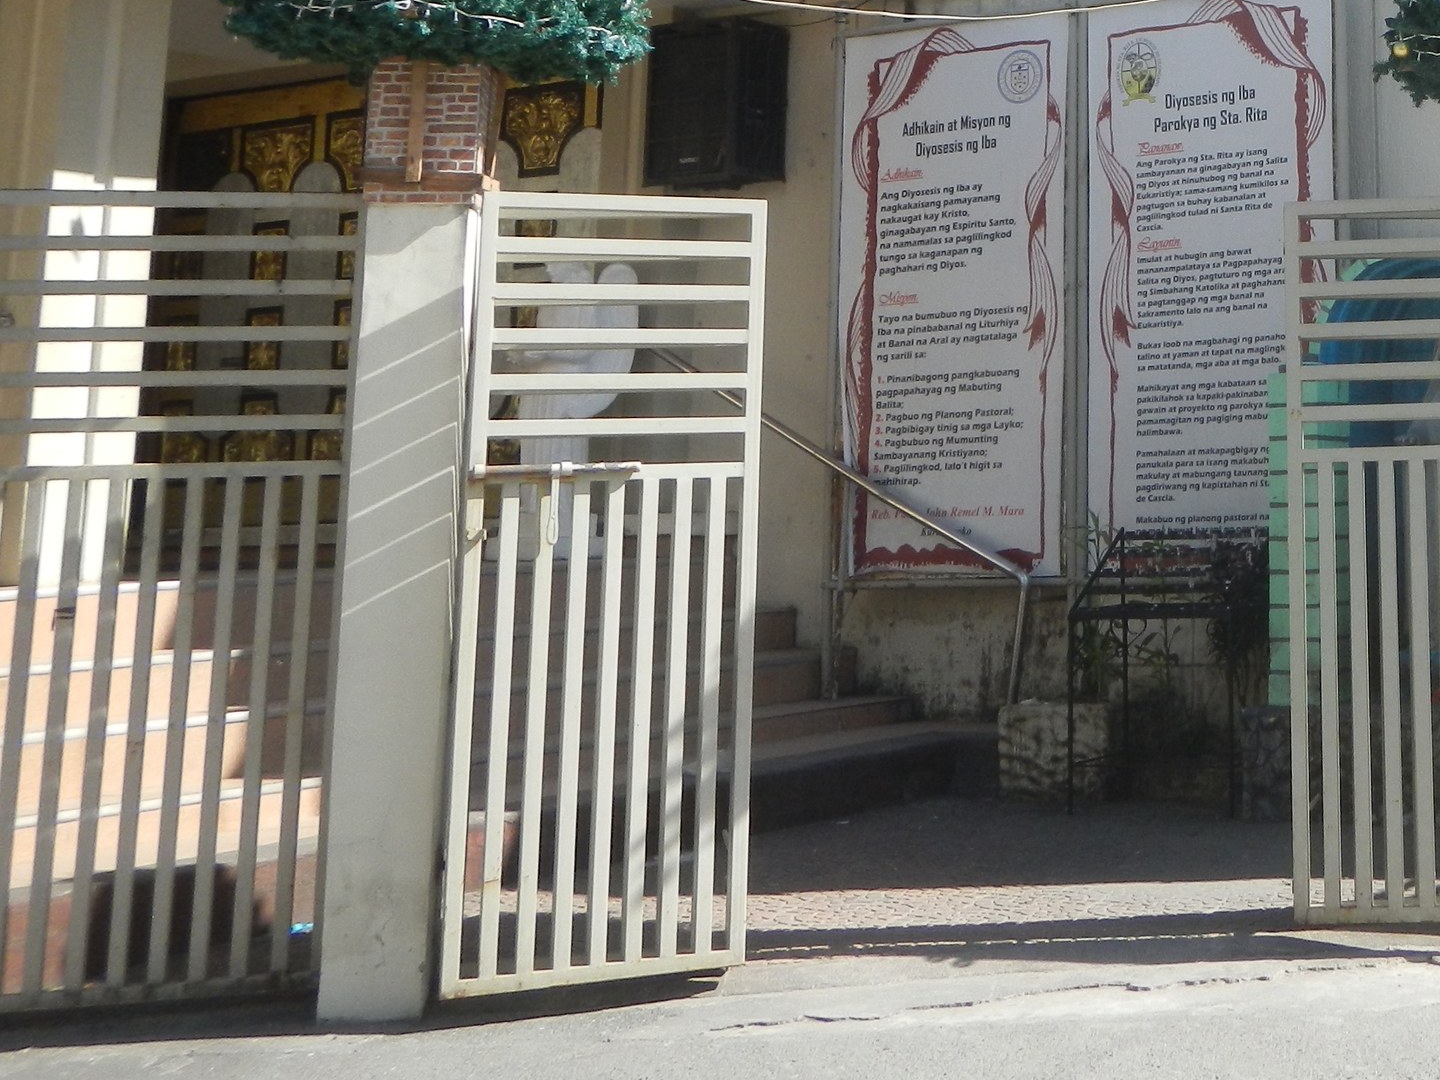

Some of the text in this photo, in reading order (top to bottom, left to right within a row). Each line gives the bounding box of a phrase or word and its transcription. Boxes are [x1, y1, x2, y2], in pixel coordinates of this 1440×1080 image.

[1165, 85, 1255, 111] Diyosesis ng Iba
[902, 115, 1010, 136] Adhikain at Misyon ng
[1154, 107, 1267, 133] Parokya ng Sta. Rita
[916, 135, 996, 158] Diyosesis ng Iba
[1154, 157, 1186, 166] Parokya
[1246, 148, 1267, 156] isang
[1136, 169, 1185, 179] sambayanan
[1199, 159, 1251, 174] ginagabayan
[1149, 170, 1262, 189] Diyos hinuhubog banal
[1240, 179, 1278, 189] kumikilos
[881, 184, 969, 201] Ang Diyosesis Iba
[881, 194, 1000, 213] nagkakaisang pamayanang
[1136, 193, 1255, 212] pagtugon buhay kabanalan
[880, 210, 969, 225] nakaugat kay Kristo,
[1136, 210, 1185, 222] paglilingkod
[1188, 208, 1208, 216] tulad
[1221, 205, 1243, 213] Santa
[880, 218, 1016, 239] ginagabayan Espiritu Santo,
[893, 230, 1011, 248] namamalas paglilingkod
[880, 248, 968, 262] tungo kaganapan
[1137, 248, 1252, 263] Imulat hubugin ang bawat
[879, 261, 966, 276] paghahari Diyos.
[1137, 257, 1282, 275] mananampalataya Pagpapahayag
[1137, 277, 1158, 285] Salita
[1200, 271, 1239, 282] pagtuturo
[1254, 268, 1271, 276] mga
[1150, 282, 1229, 296] Simbahang Katolika
[1148, 292, 1252, 308] pagtanggap mga banal
[878, 305, 1028, 325] Tayo bumubuo Diyosesis ng
[1137, 309, 1184, 318] Sakramento
[1215, 305, 1230, 313] ang
[1233, 303, 1255, 311] banal
[878, 319, 1019, 337] Iba pinababanal Liturhiya
[889, 332, 1017, 347] Banal Aral nagtatalaga
[1195, 336, 1240, 347] magbahagi
[891, 351, 912, 360] sarili
[1173, 351, 1199, 360] yaman
[1212, 349, 1232, 357] tapat
[1196, 361, 1212, 369] mga
[1215, 359, 1229, 367] aba
[1242, 357, 1259, 366] mga
[887, 369, 1019, 383] Pinanibagong pangkabuoang
[876, 382, 1002, 398] pagpapahayag Mabuting
[1137, 379, 1256, 393] Mahikayat ang mga kabataan
[1137, 394, 1183, 404] pakikilahok
[1137, 401, 1263, 416] gawain proyekto parokya
[886, 413, 918, 423] Pagbuo
[935, 410, 972, 419] Planong
[1137, 413, 1243, 427] pamamagitan pagiging
[885, 426, 934, 436] Pagbibigay
[938, 424, 958, 433] tinig
[972, 422, 991, 432] mga
[885, 435, 998, 448] Pagbubuo Mumunting
[874, 451, 936, 461] Sambayanang
[1136, 446, 1258, 458] Pamahalaan makapagbigay
[970, 461, 990, 471] higit
[1136, 458, 1228, 470] panukala para isang
[1136, 471, 1170, 480] makulay
[1182, 470, 1231, 478] mabungang
[1136, 481, 1247, 492] pagdiriwang kapistahan
[1136, 514, 1257, 524] Makabuo planong pastoral
